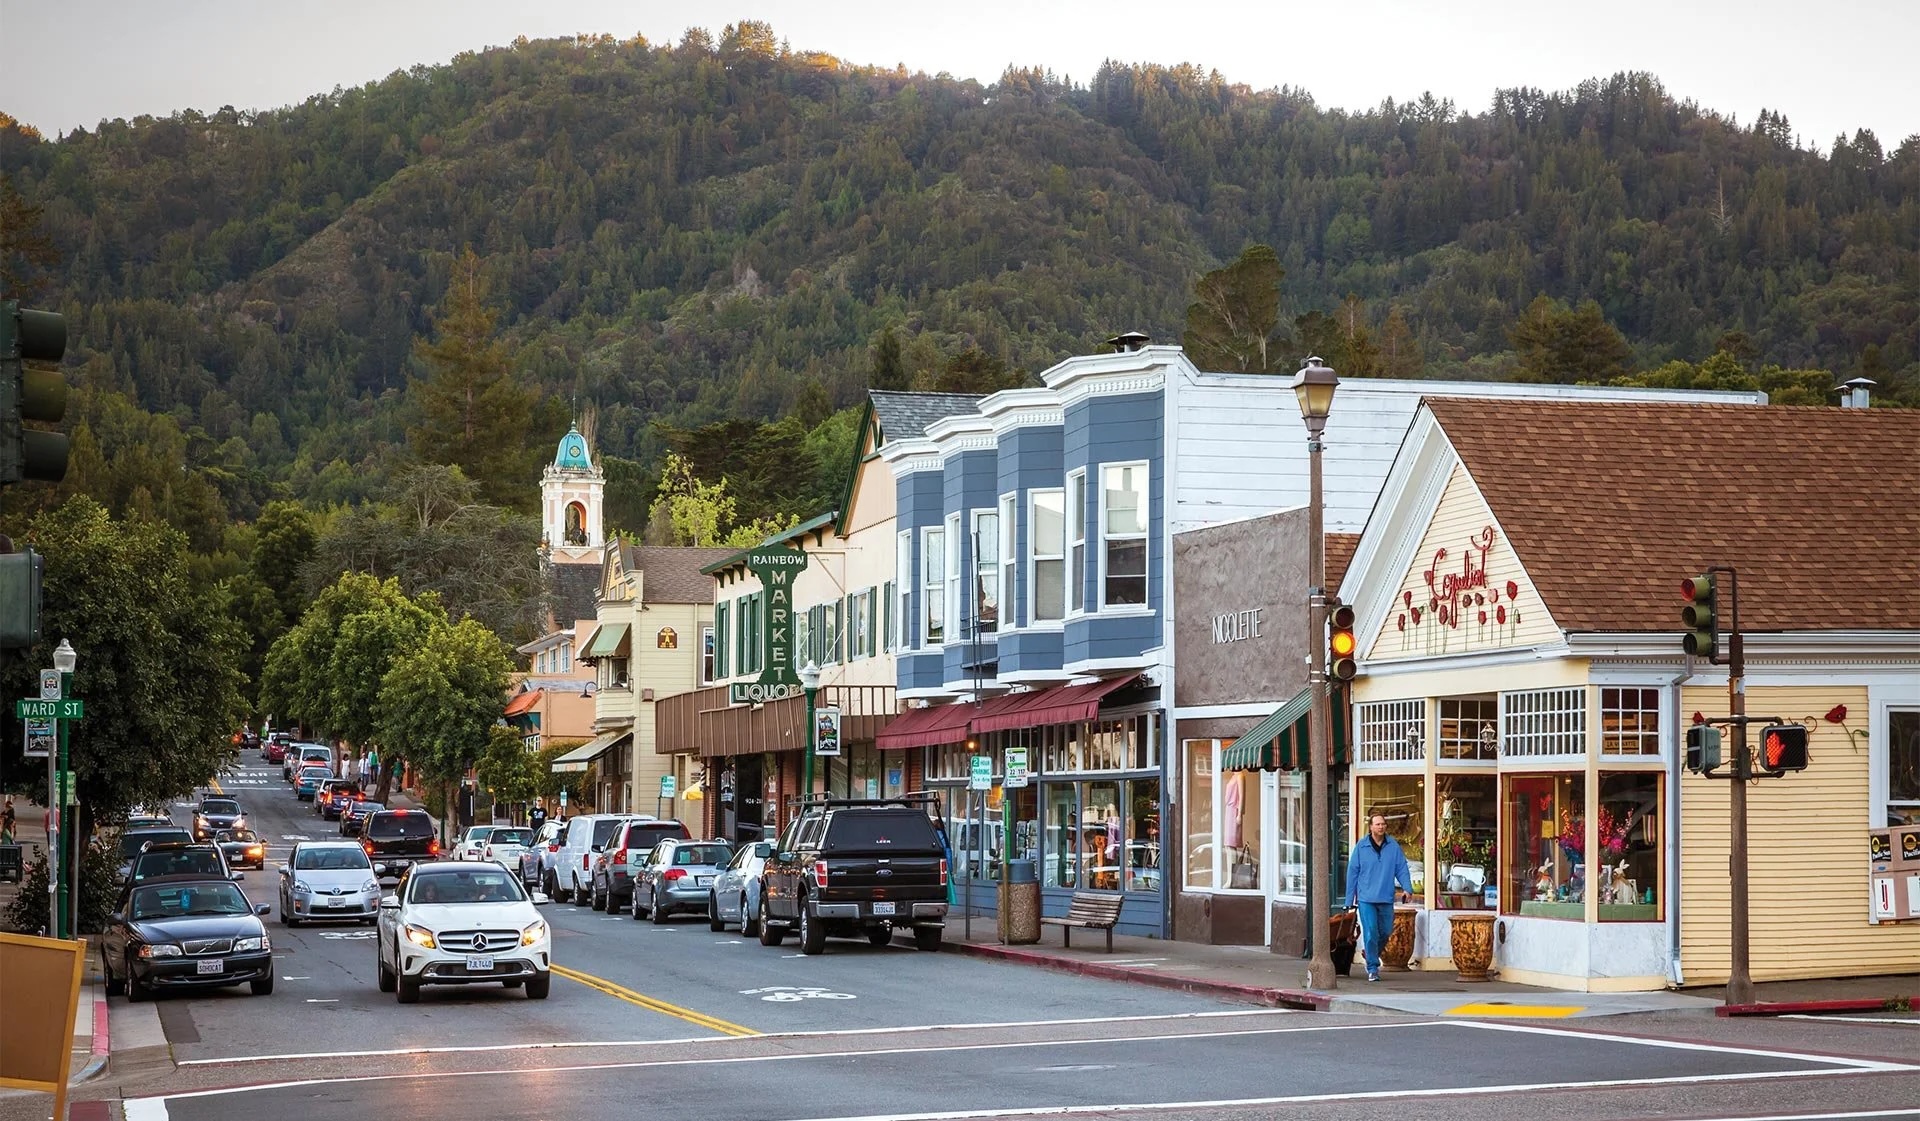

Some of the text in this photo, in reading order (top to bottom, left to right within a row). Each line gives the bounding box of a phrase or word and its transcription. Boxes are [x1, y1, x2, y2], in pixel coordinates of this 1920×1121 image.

[753, 555, 805, 566] RAINBOW
[771, 570, 787, 682] MARKET
[1212, 607, 1263, 645] NICOLETTE
[22, 702, 79, 716] WARD ST
